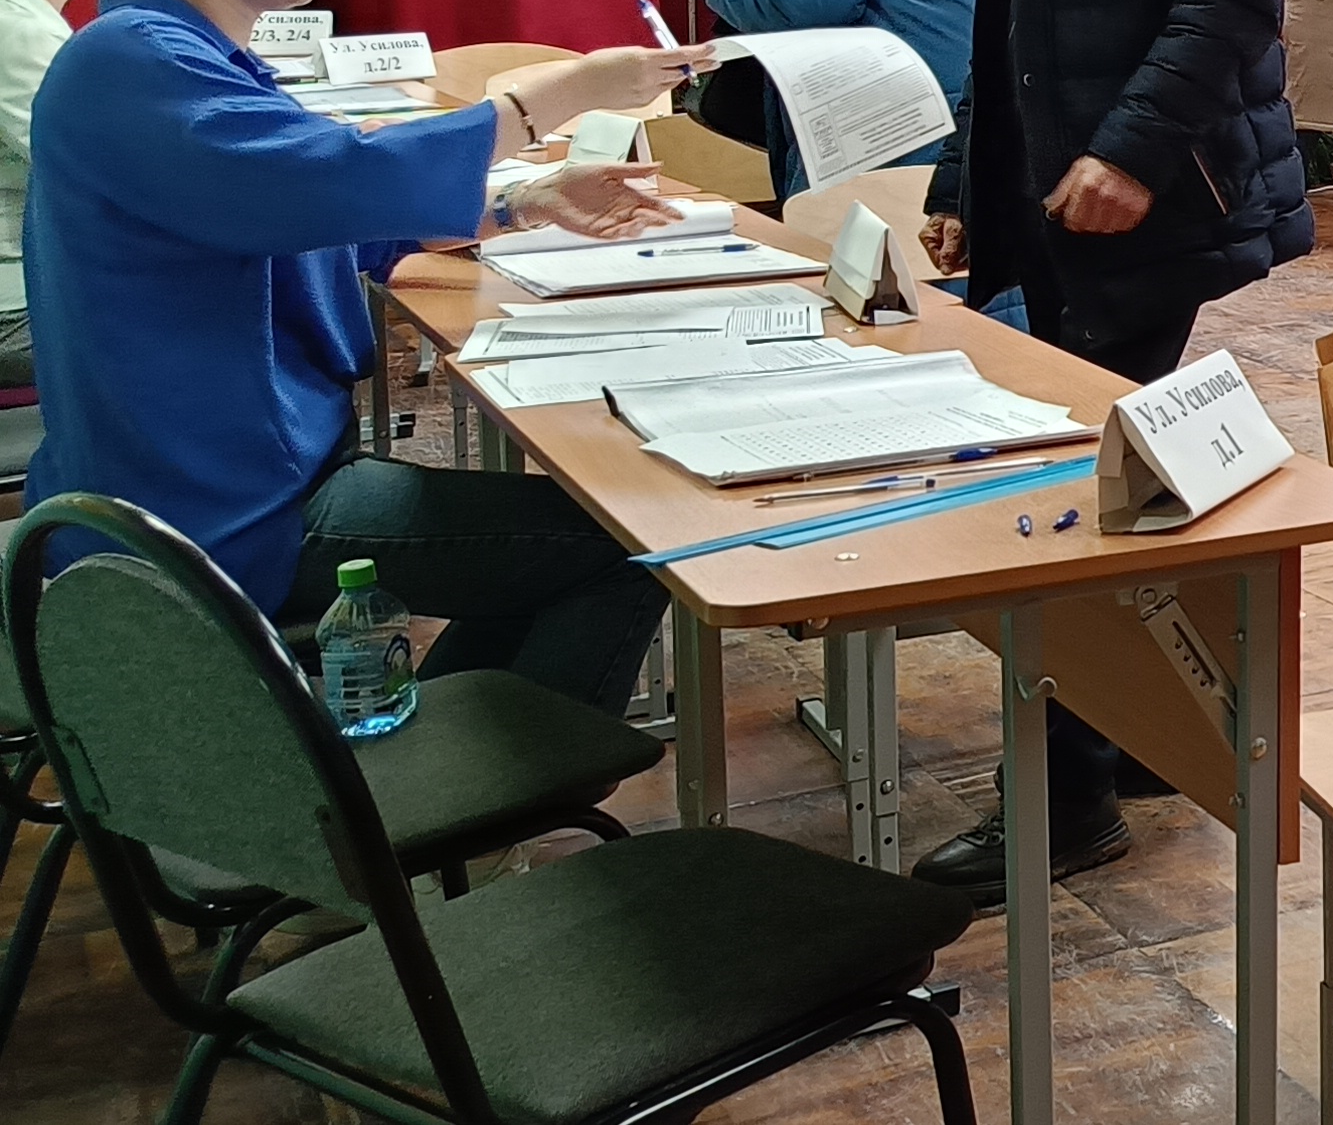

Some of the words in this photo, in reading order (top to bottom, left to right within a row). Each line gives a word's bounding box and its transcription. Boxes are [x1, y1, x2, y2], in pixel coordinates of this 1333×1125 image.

[286, 29, 311, 41] 2/4
[329, 41, 356, 54] Ул.
[360, 37, 424, 53] Усилова,
[363, 56, 402, 74] д.2/2
[1134, 401, 1178, 434] Ул.
[1166, 369, 1244, 416] Усилова,
[1210, 422, 1244, 470] д.1
